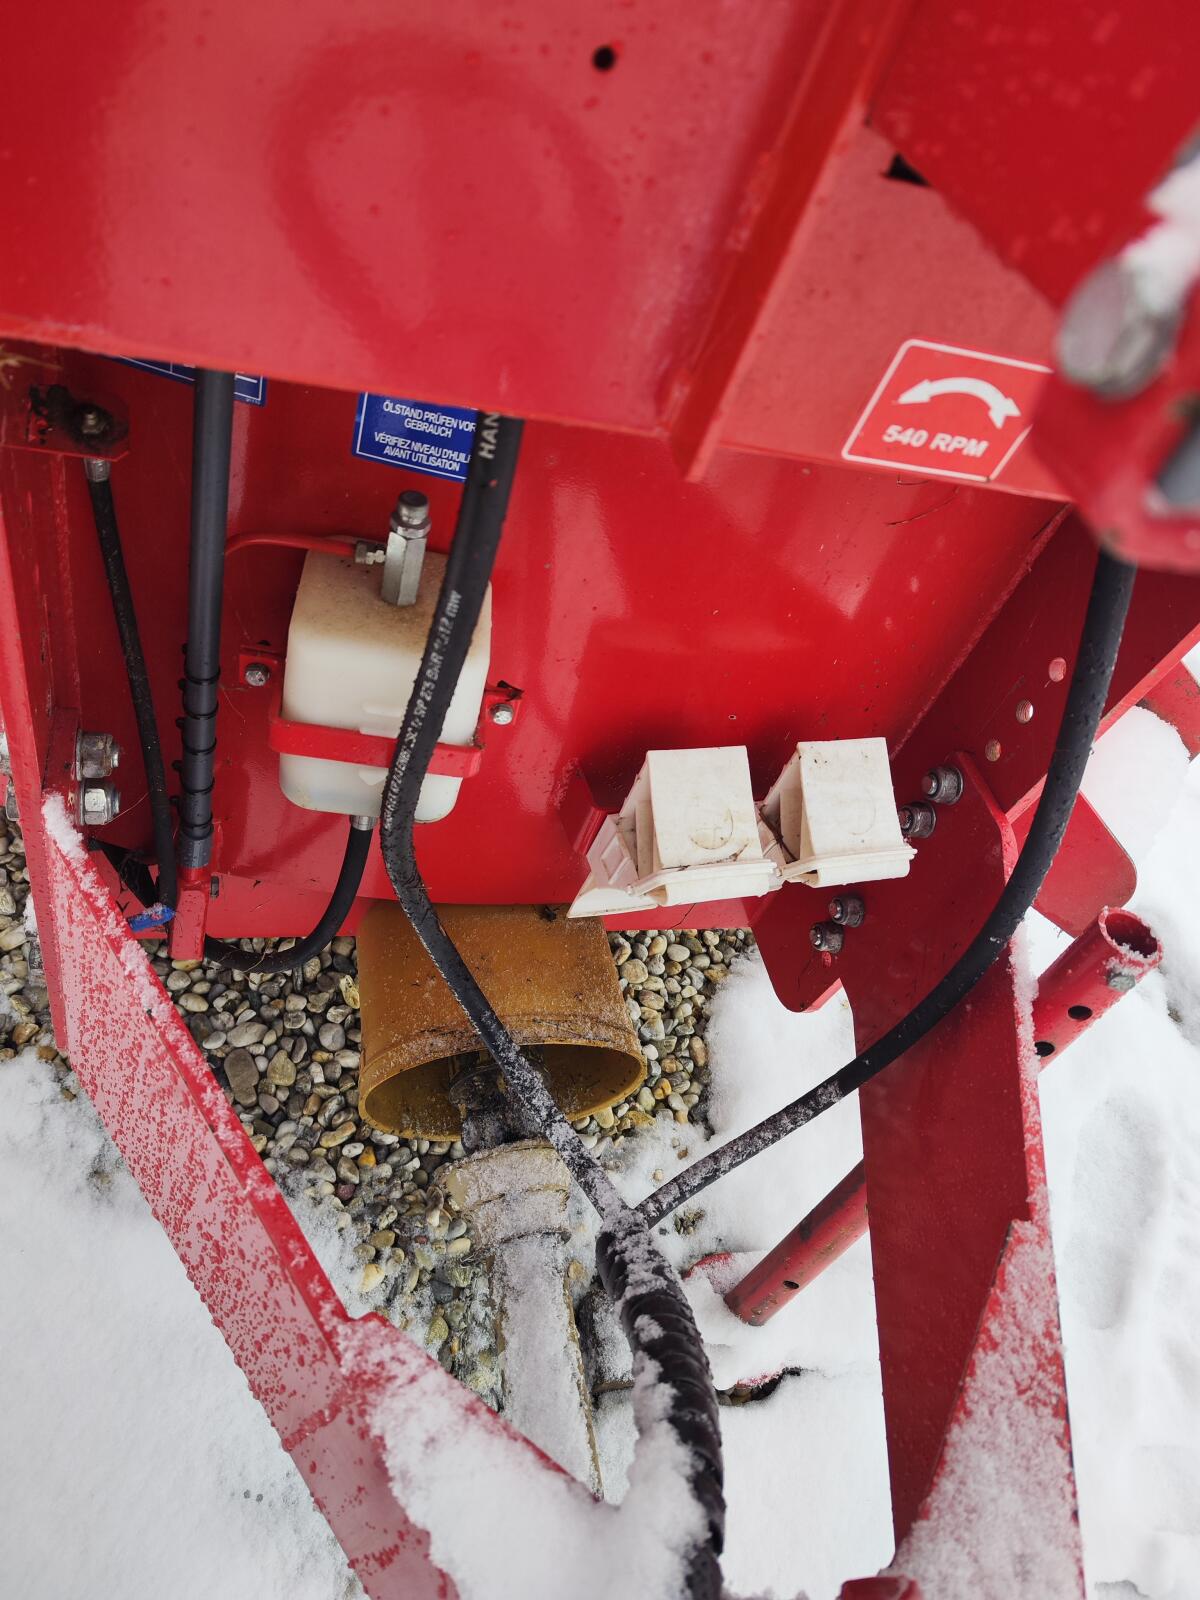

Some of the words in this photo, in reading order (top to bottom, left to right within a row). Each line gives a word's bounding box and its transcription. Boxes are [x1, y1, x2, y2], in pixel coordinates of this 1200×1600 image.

[382, 399, 423, 421] ÖLSTAND
[423, 411, 457, 429] PRÜFEN
[457, 419, 477, 432] VOR
[404, 418, 453, 438] GEBRAUCH
[374, 431, 412, 449] VÉRIFIEZ
[411, 441, 443, 457] NIVEAU
[882, 424, 929, 448] 540
[929, 432, 990, 458] RPM
[384, 446, 412, 460] AVANT
[411, 452, 460, 472] UTILISATION
